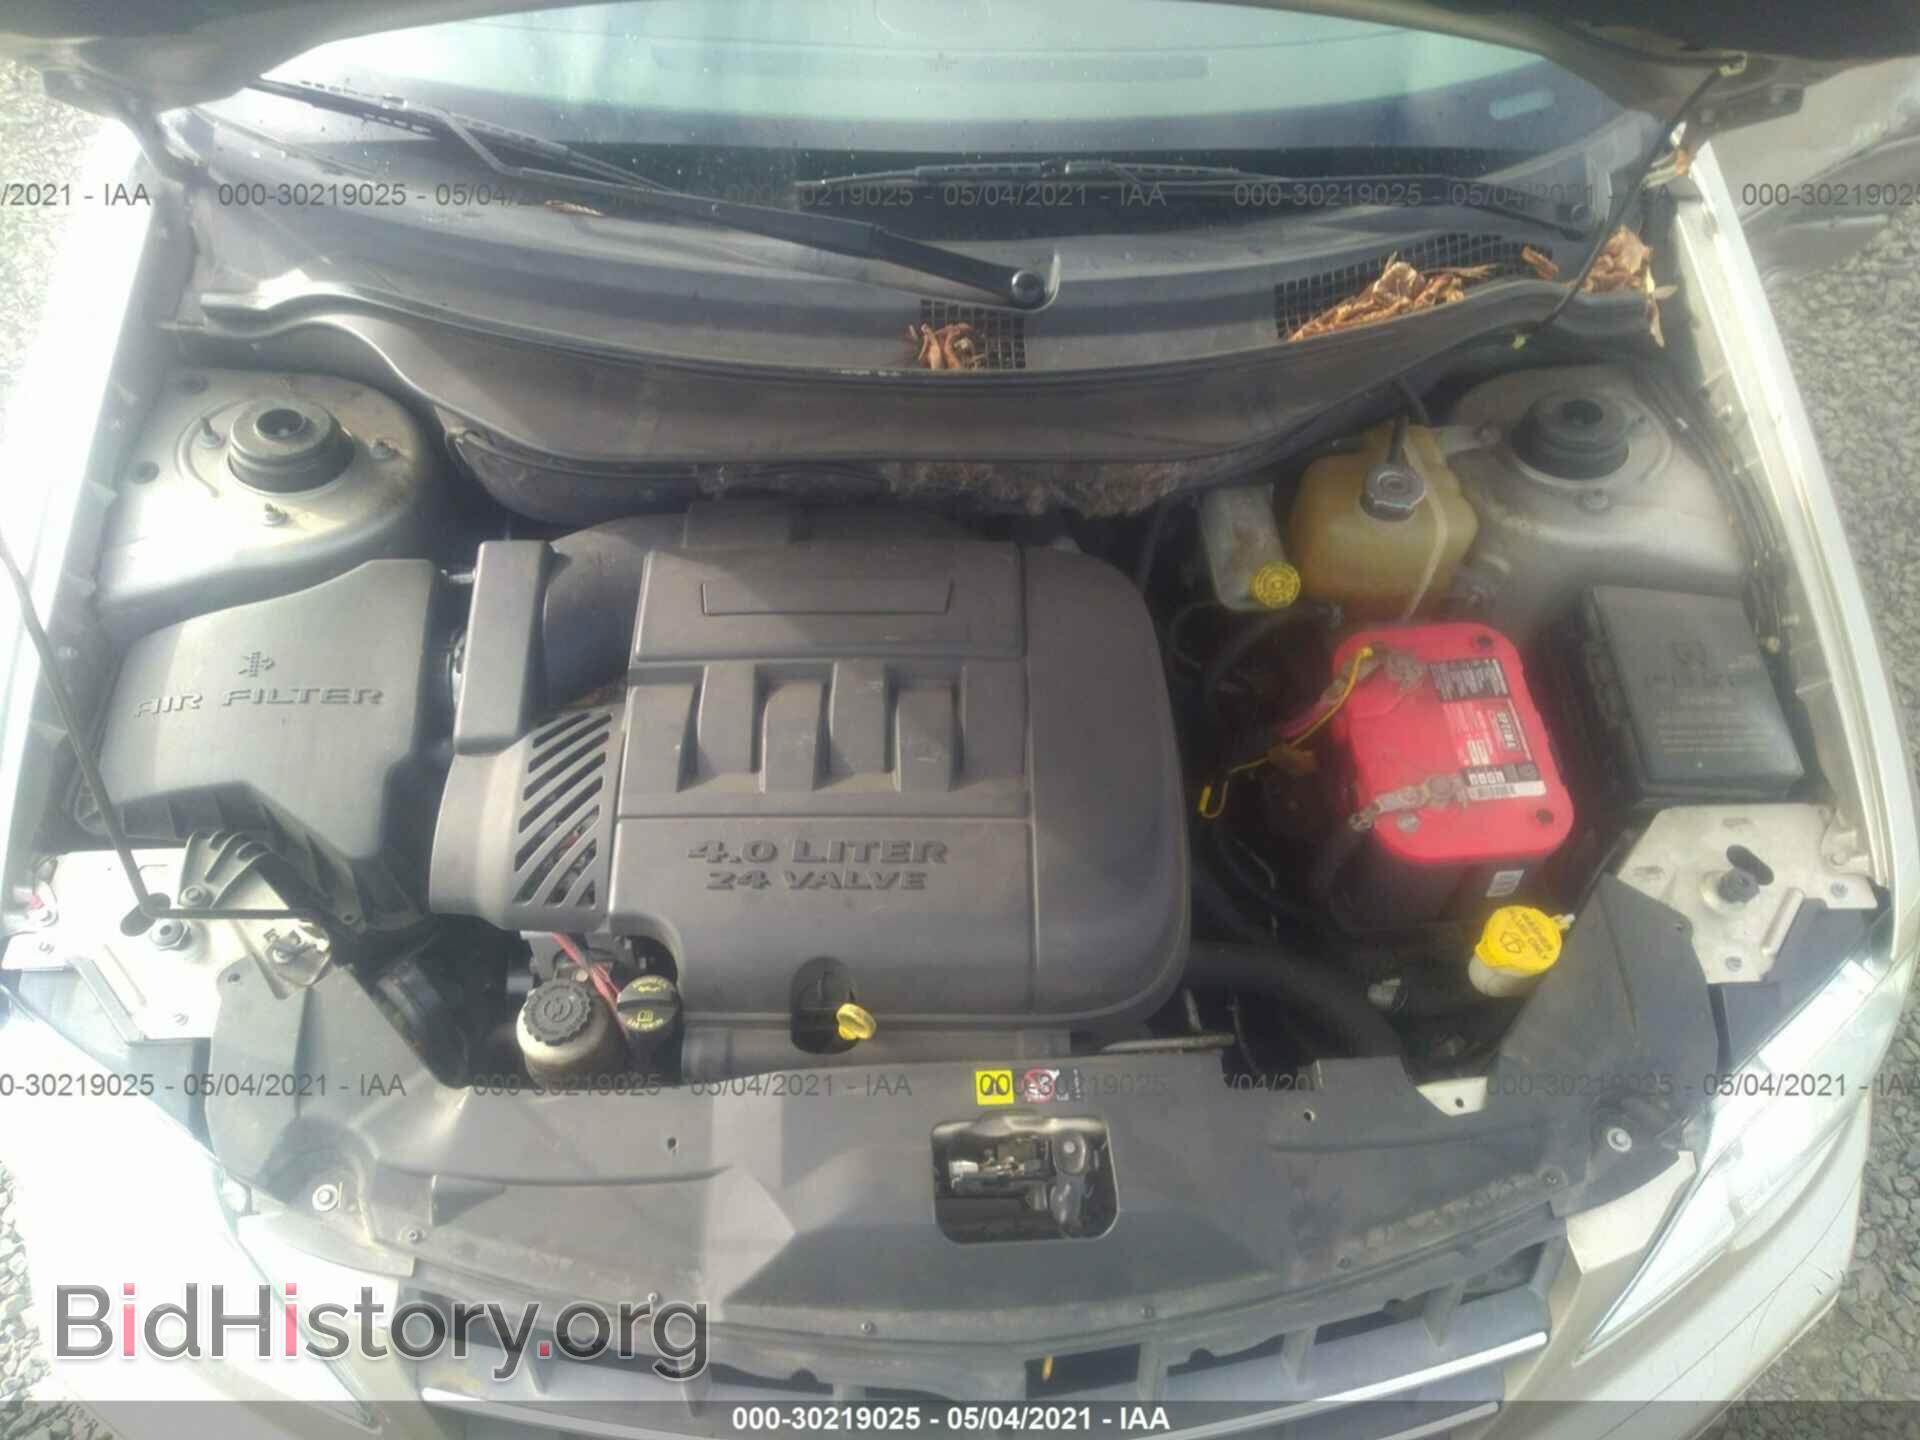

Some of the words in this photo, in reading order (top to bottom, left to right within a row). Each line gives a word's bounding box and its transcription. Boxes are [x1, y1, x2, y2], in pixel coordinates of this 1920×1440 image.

[134, 695, 204, 718] AIR
[222, 688, 384, 706] FILTER
[688, 840, 778, 864] 4.0
[792, 840, 948, 864] LITER
[706, 870, 771, 890] 24
[784, 870, 928, 891] VALVE
